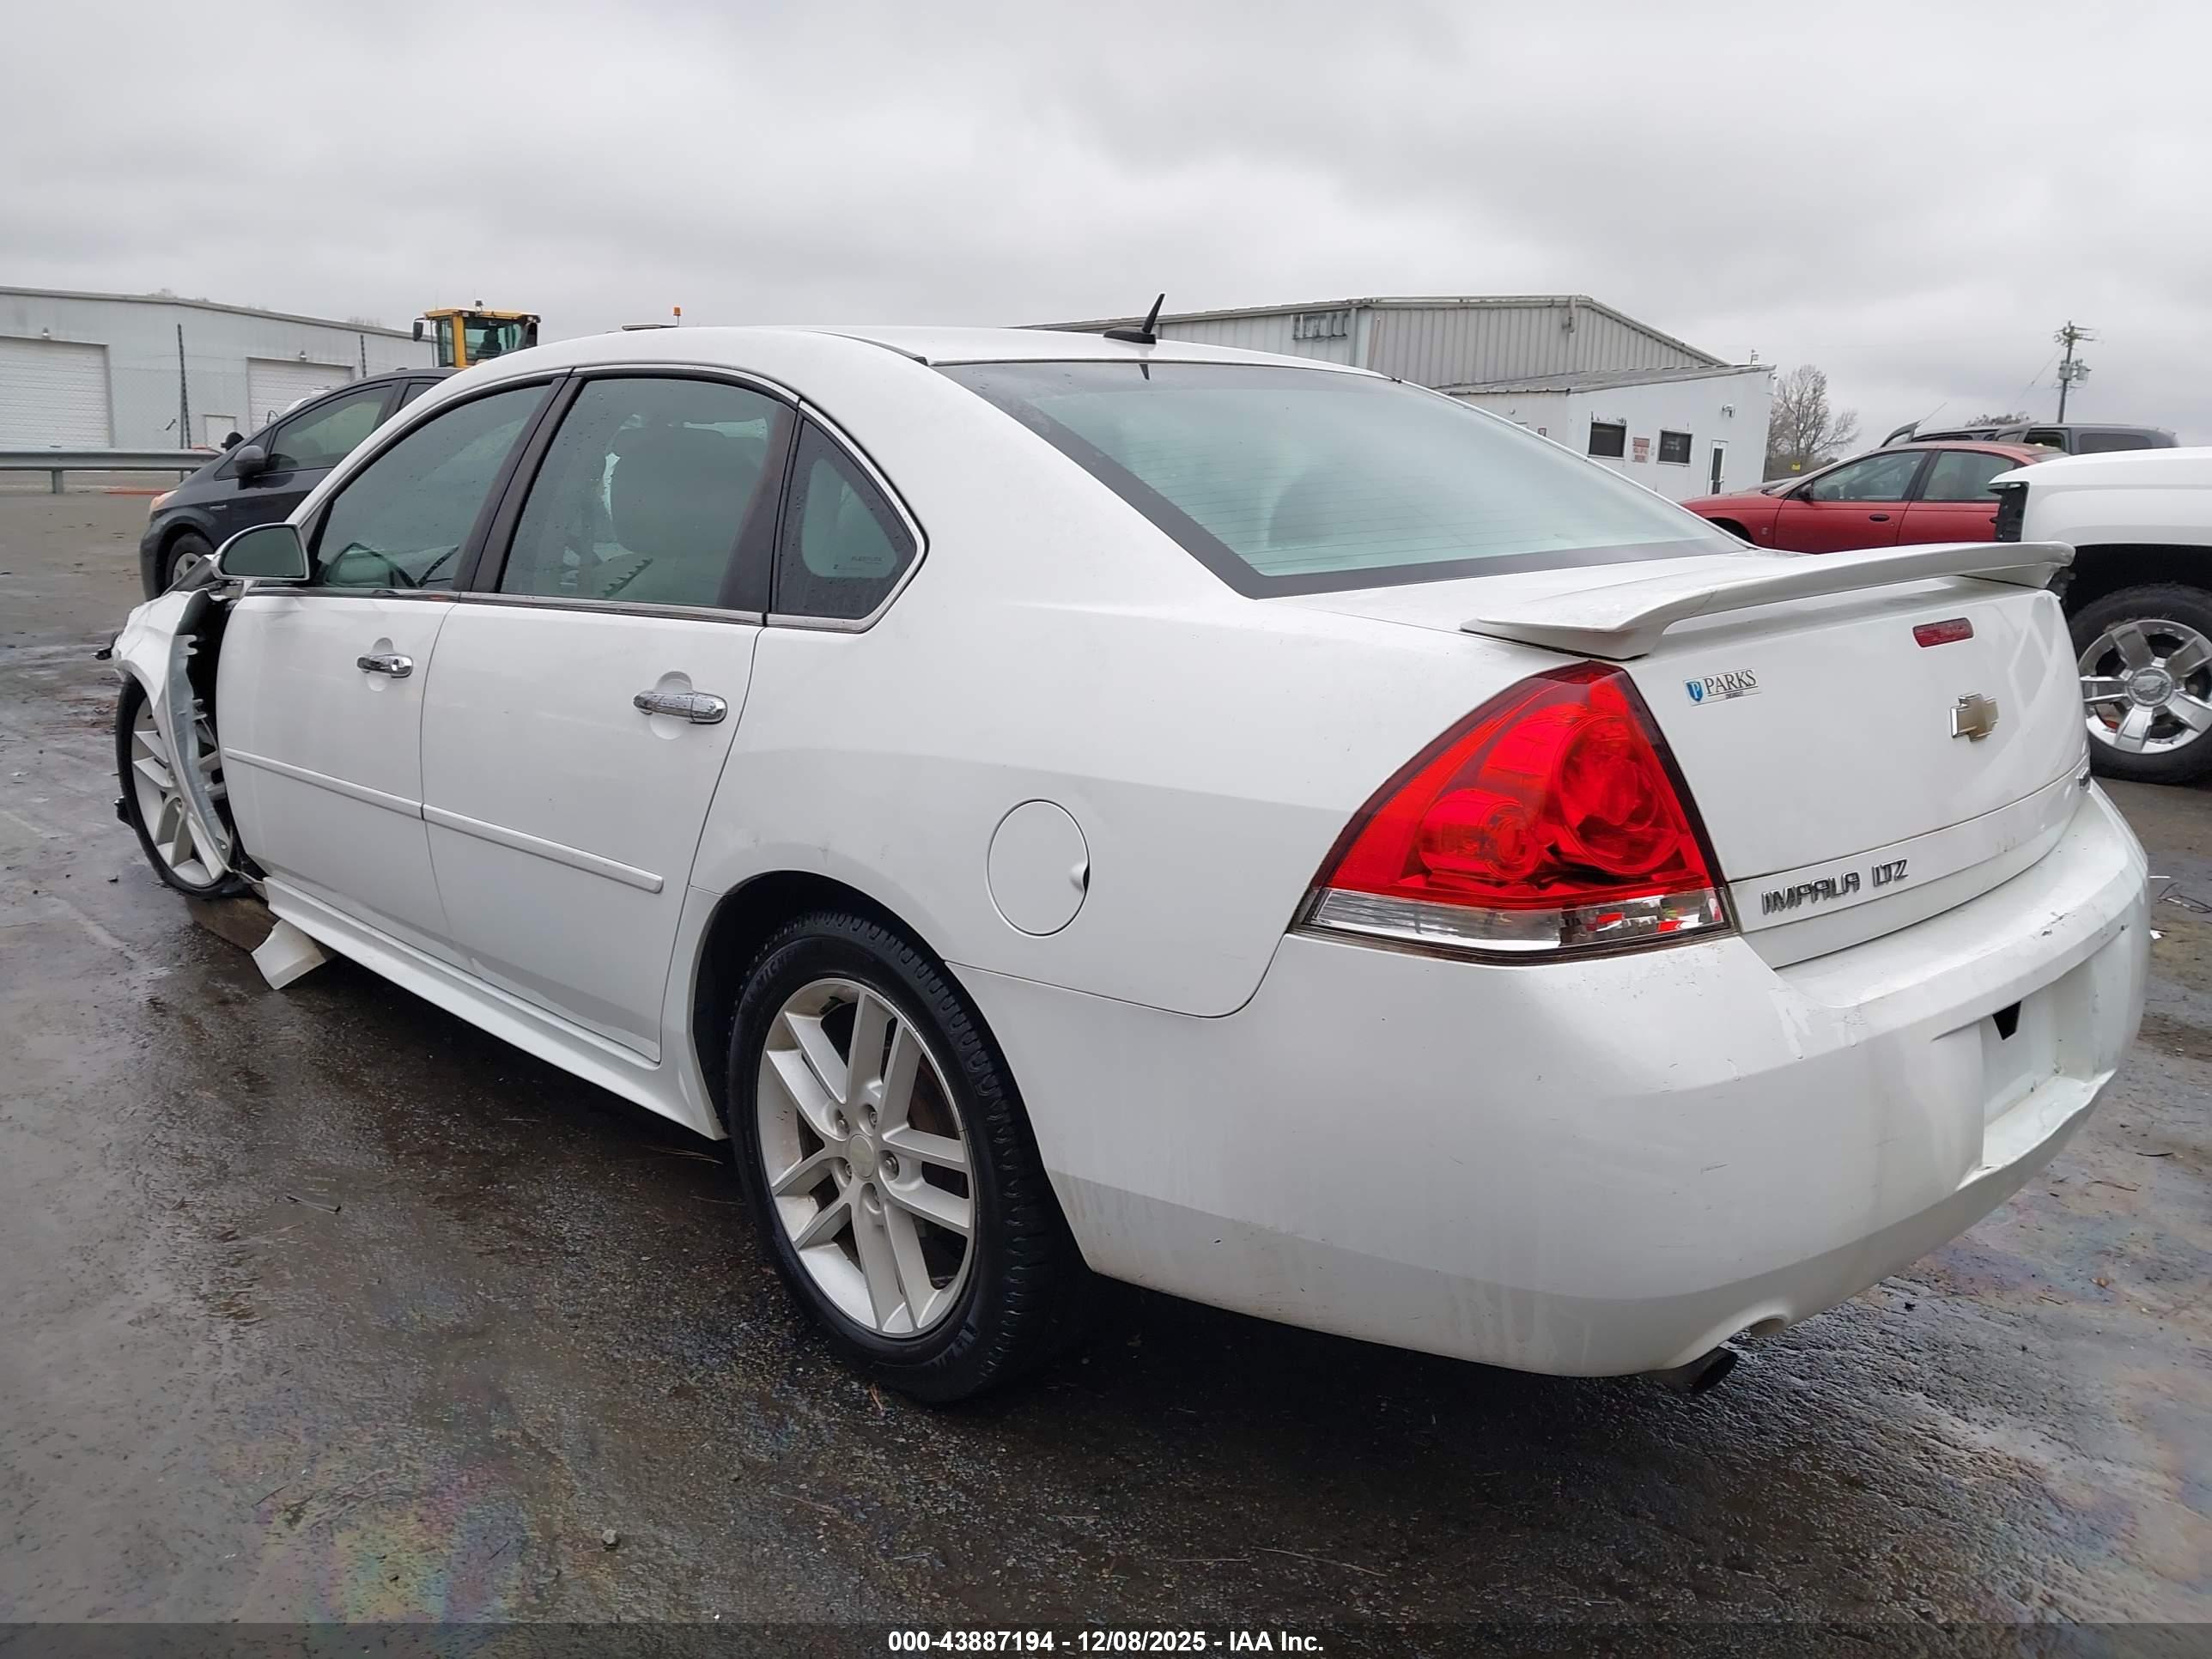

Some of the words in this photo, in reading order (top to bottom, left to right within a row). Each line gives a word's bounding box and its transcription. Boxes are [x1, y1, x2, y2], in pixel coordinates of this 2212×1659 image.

[1704, 669, 1757, 695] PARKS
[1762, 872, 1861, 915] IMPALA
[1872, 858, 1909, 887] LTZ
